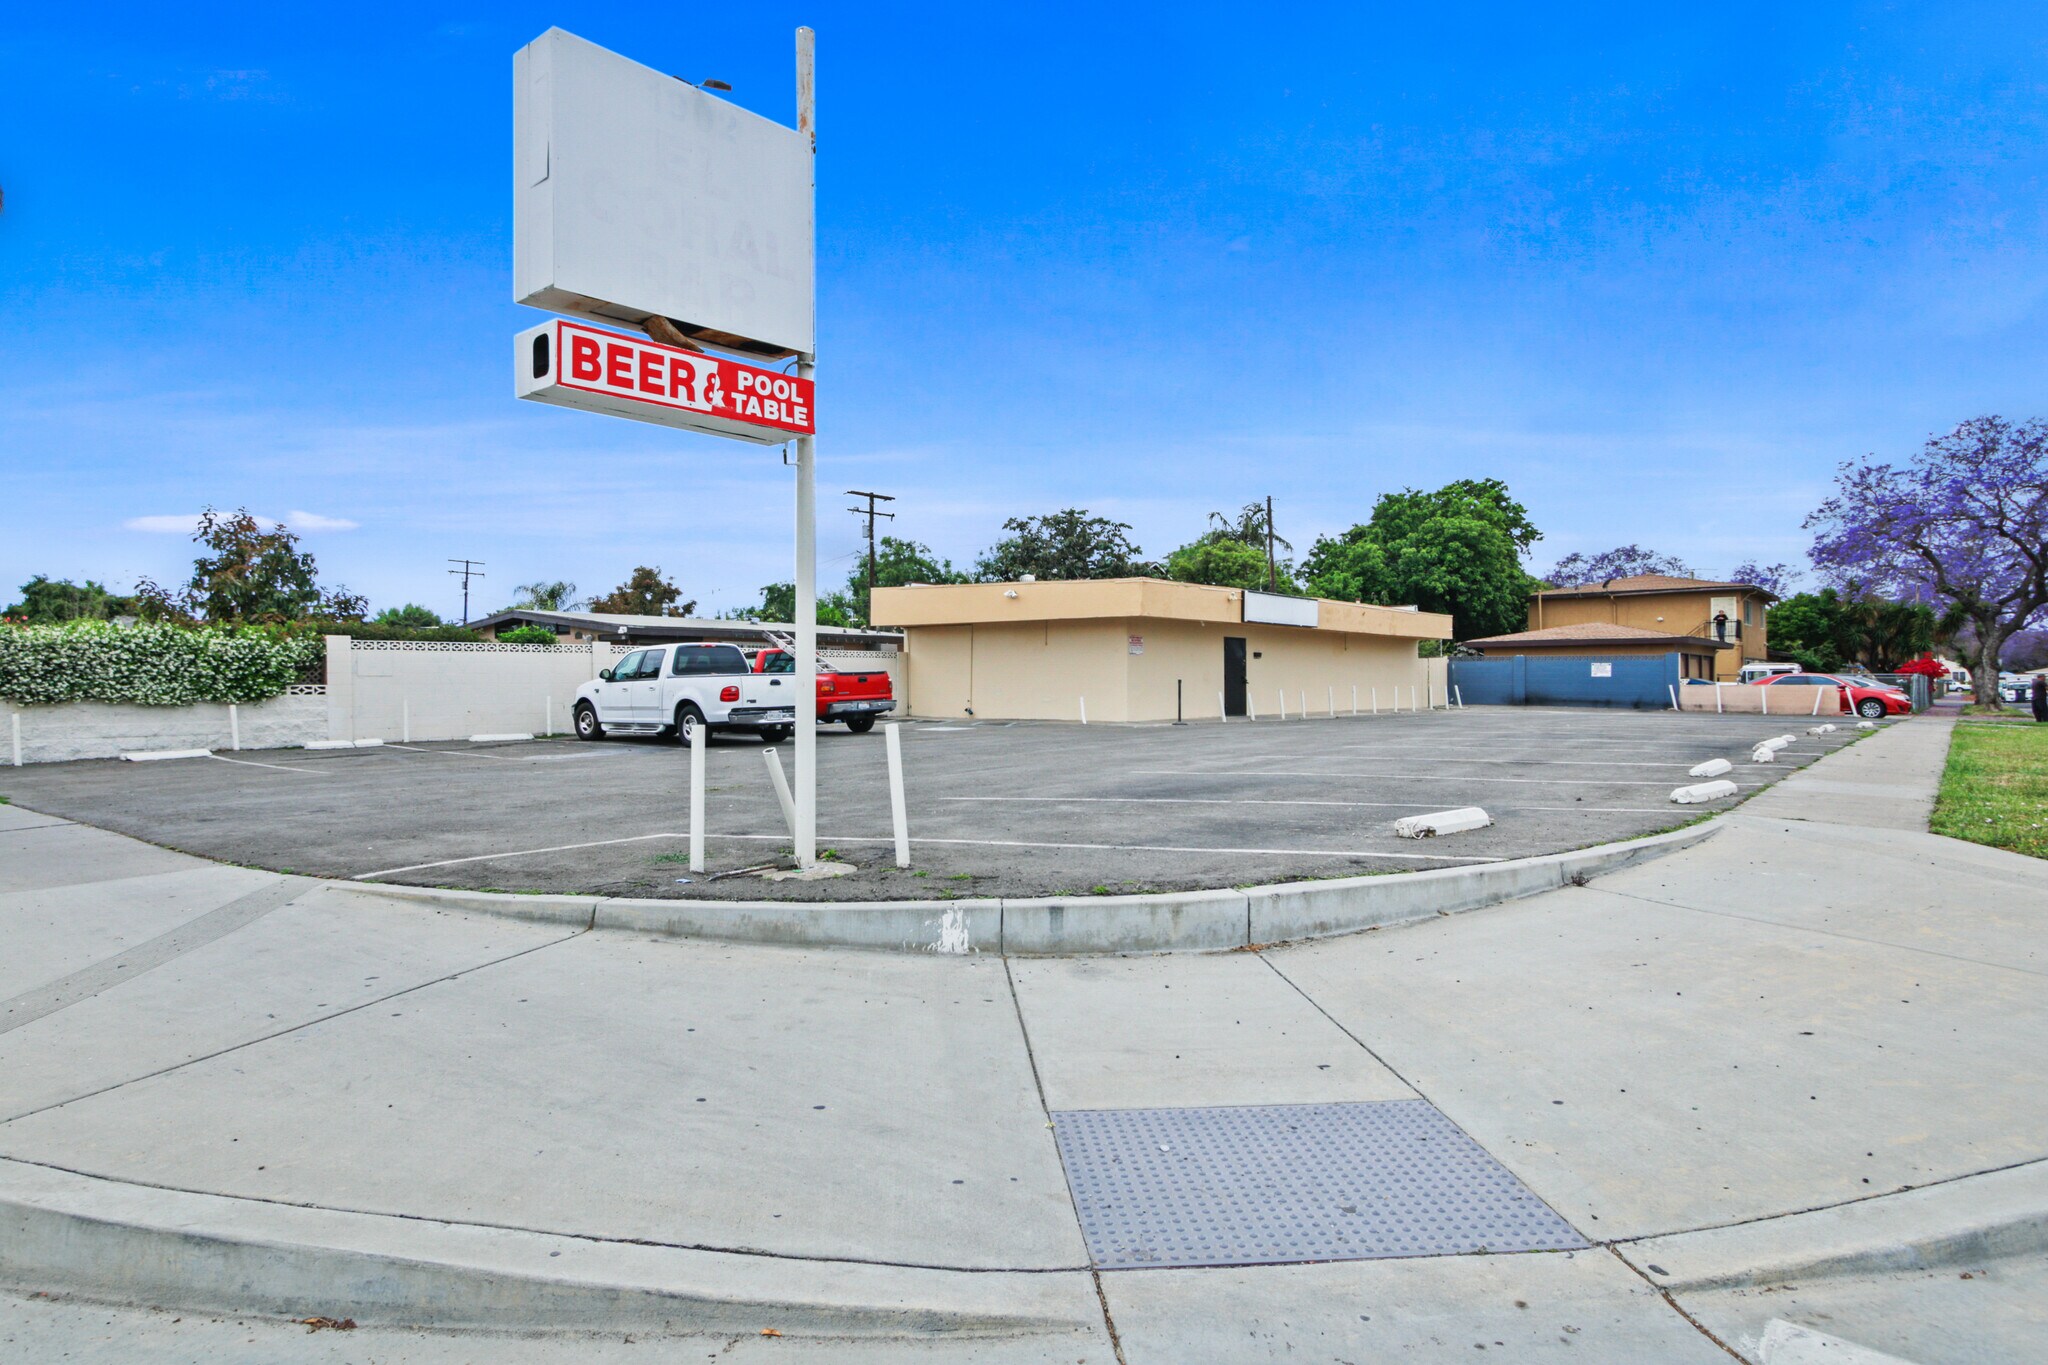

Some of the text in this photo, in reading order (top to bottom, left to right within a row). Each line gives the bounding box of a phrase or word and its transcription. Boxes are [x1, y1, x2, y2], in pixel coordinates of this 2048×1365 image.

[572, 334, 726, 408] BEER &
[737, 370, 804, 404] POOL
[731, 391, 809, 427] TABLE
